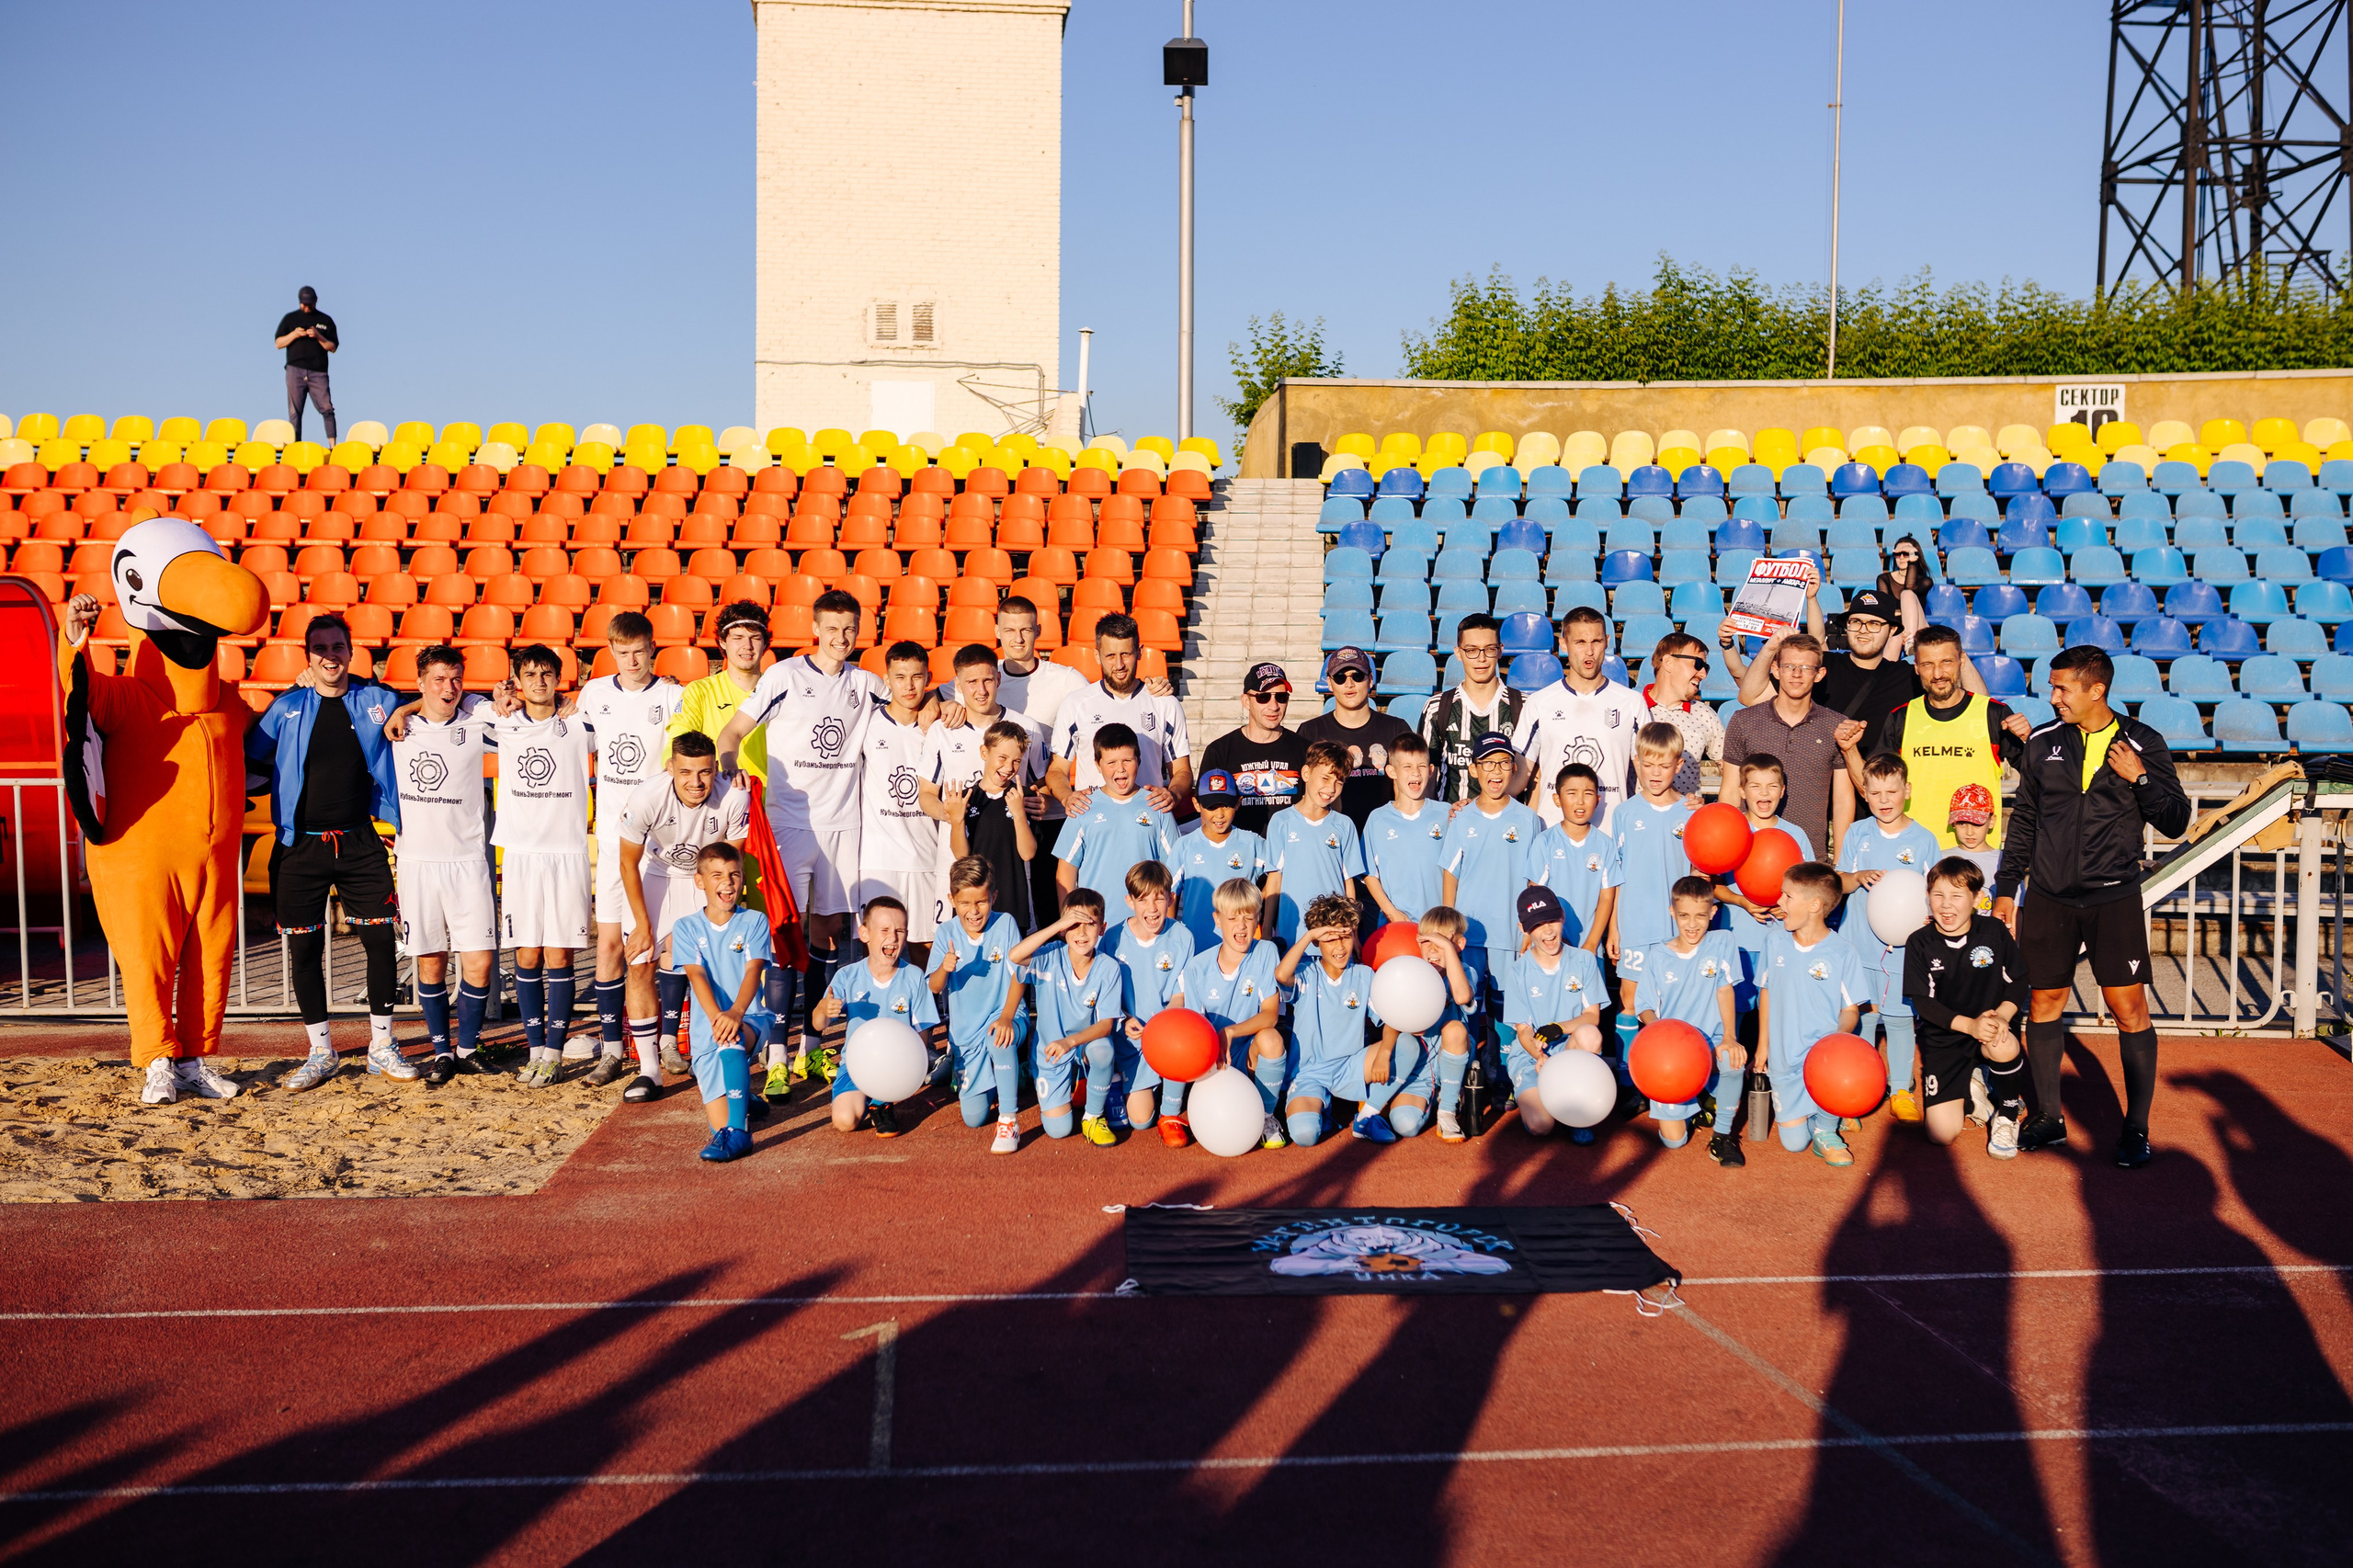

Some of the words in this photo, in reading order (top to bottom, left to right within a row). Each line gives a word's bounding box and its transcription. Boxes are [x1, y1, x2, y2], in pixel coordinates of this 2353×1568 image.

[2061, 389, 2119, 405] СЕКТОР
[1754, 562, 1810, 580] ФУТБОЛ
[1781, 578, 1806, 588] АМКАР-2
[1455, 744, 1472, 756] Te
[1913, 746, 1963, 757] KELME
[794, 759, 856, 769] КубаньЭнерРемо
[1241, 759, 1269, 772] ЮЖНЫЙ
[1270, 761, 1290, 770] УРАЛ
[1242, 796, 1291, 806] МАГНИТОГОРСК
[1527, 901, 1547, 913] FILA
[1624, 949, 1644, 971] 22
[1251, 1215, 1516, 1252] МАГНИТОГОРСК
